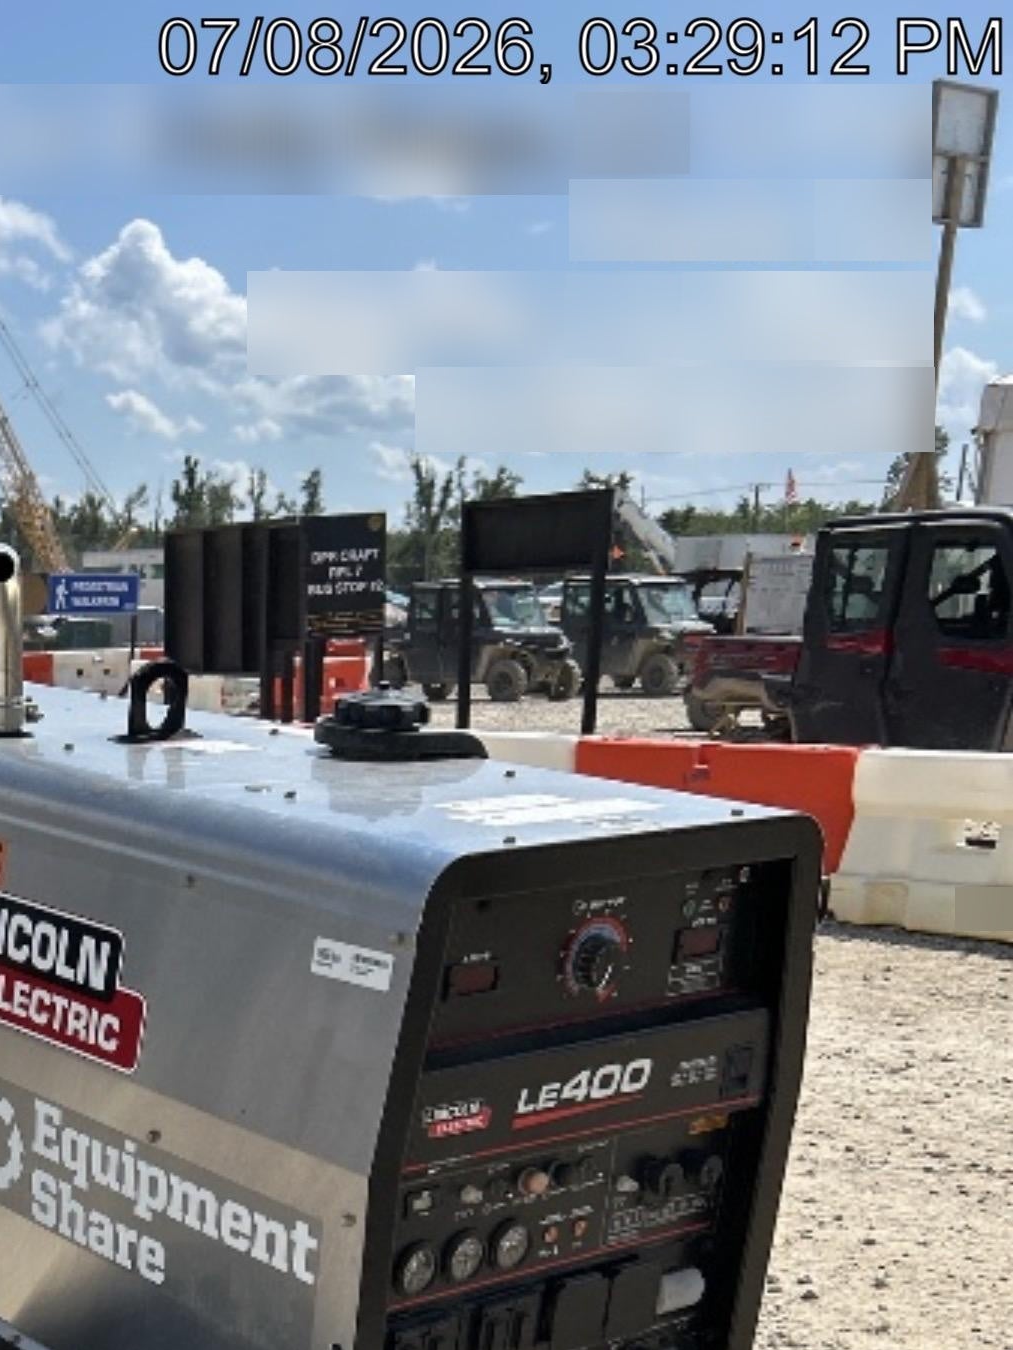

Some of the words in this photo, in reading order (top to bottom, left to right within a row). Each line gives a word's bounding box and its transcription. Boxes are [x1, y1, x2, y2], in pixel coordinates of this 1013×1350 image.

[335, 581, 367, 594] STOP
[517, 1058, 652, 1114] LE400
[31, 1098, 319, 1286] Equipment
[31, 1168, 166, 1286] Share
